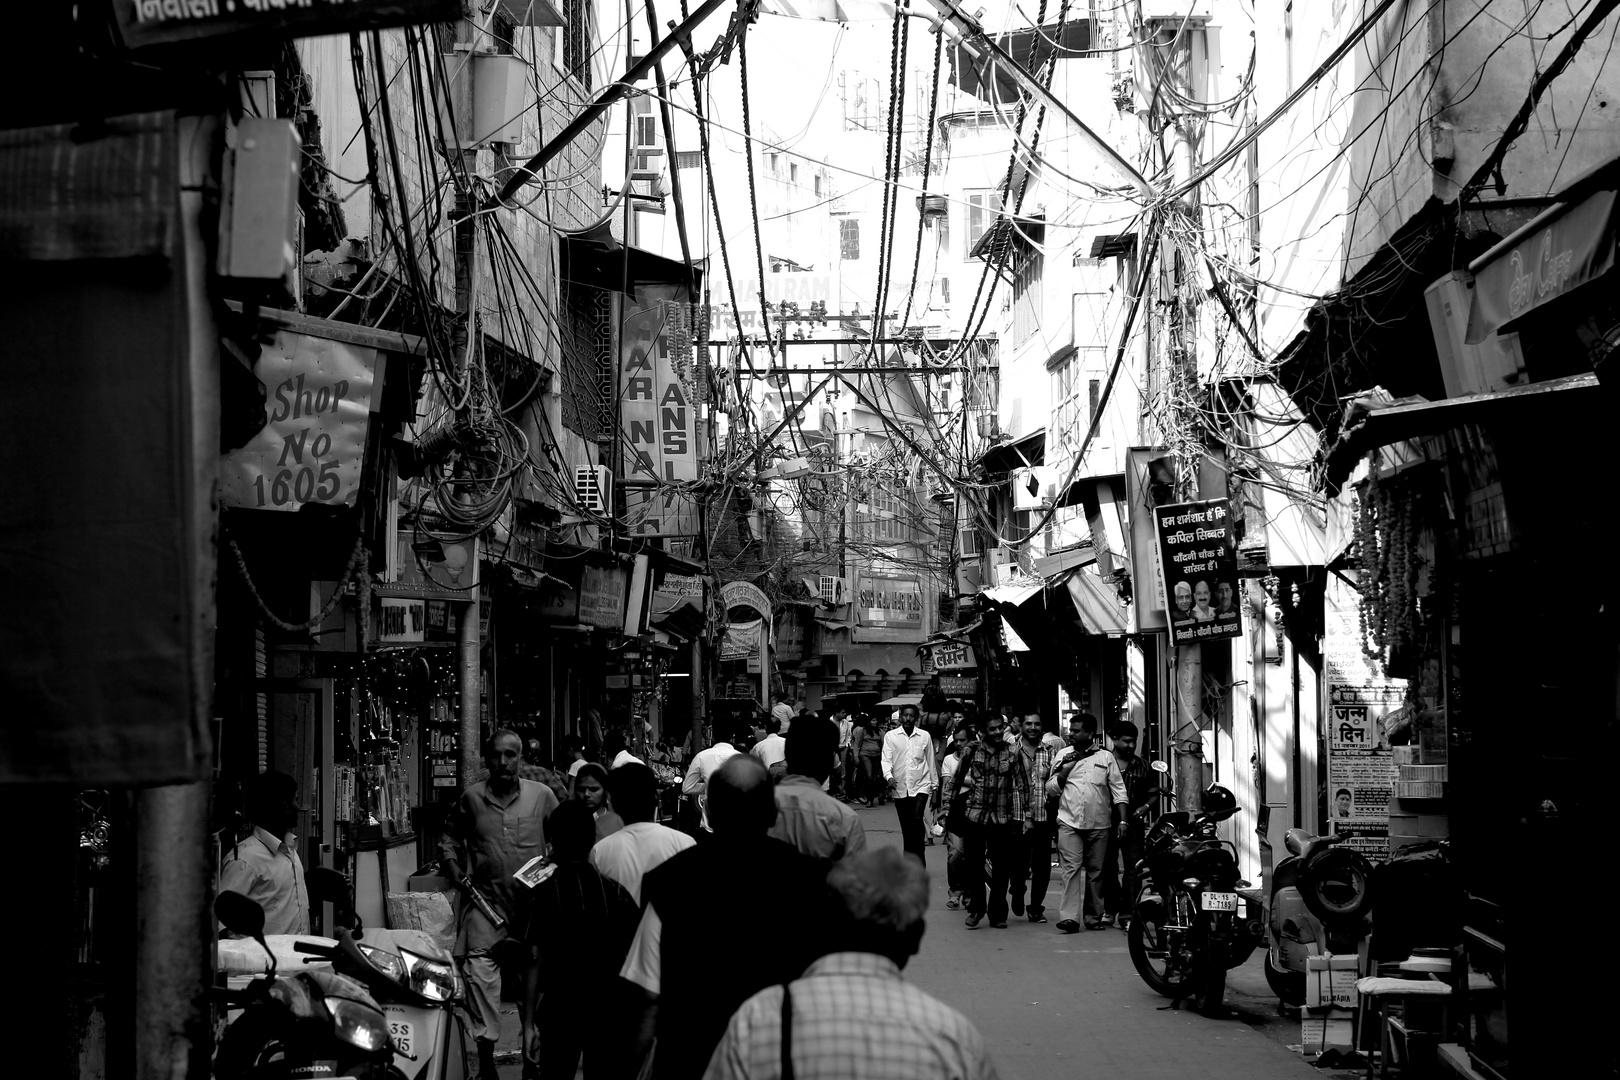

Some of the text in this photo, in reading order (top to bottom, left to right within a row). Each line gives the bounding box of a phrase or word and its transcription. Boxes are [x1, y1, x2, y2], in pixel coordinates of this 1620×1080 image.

[269, 372, 350, 425] Shop
[253, 459, 341, 507] 1605
[1161, 516, 1175, 528] हम
[1214, 506, 1227, 520] कि
[1166, 530, 1195, 545] कपिल
[1198, 547, 1216, 560] चौक
[1216, 546, 1225, 558] से
[1183, 563, 1206, 575] सांसद
[1334, 706, 1368, 722] जन्म
[1339, 722, 1365, 743] दिन
